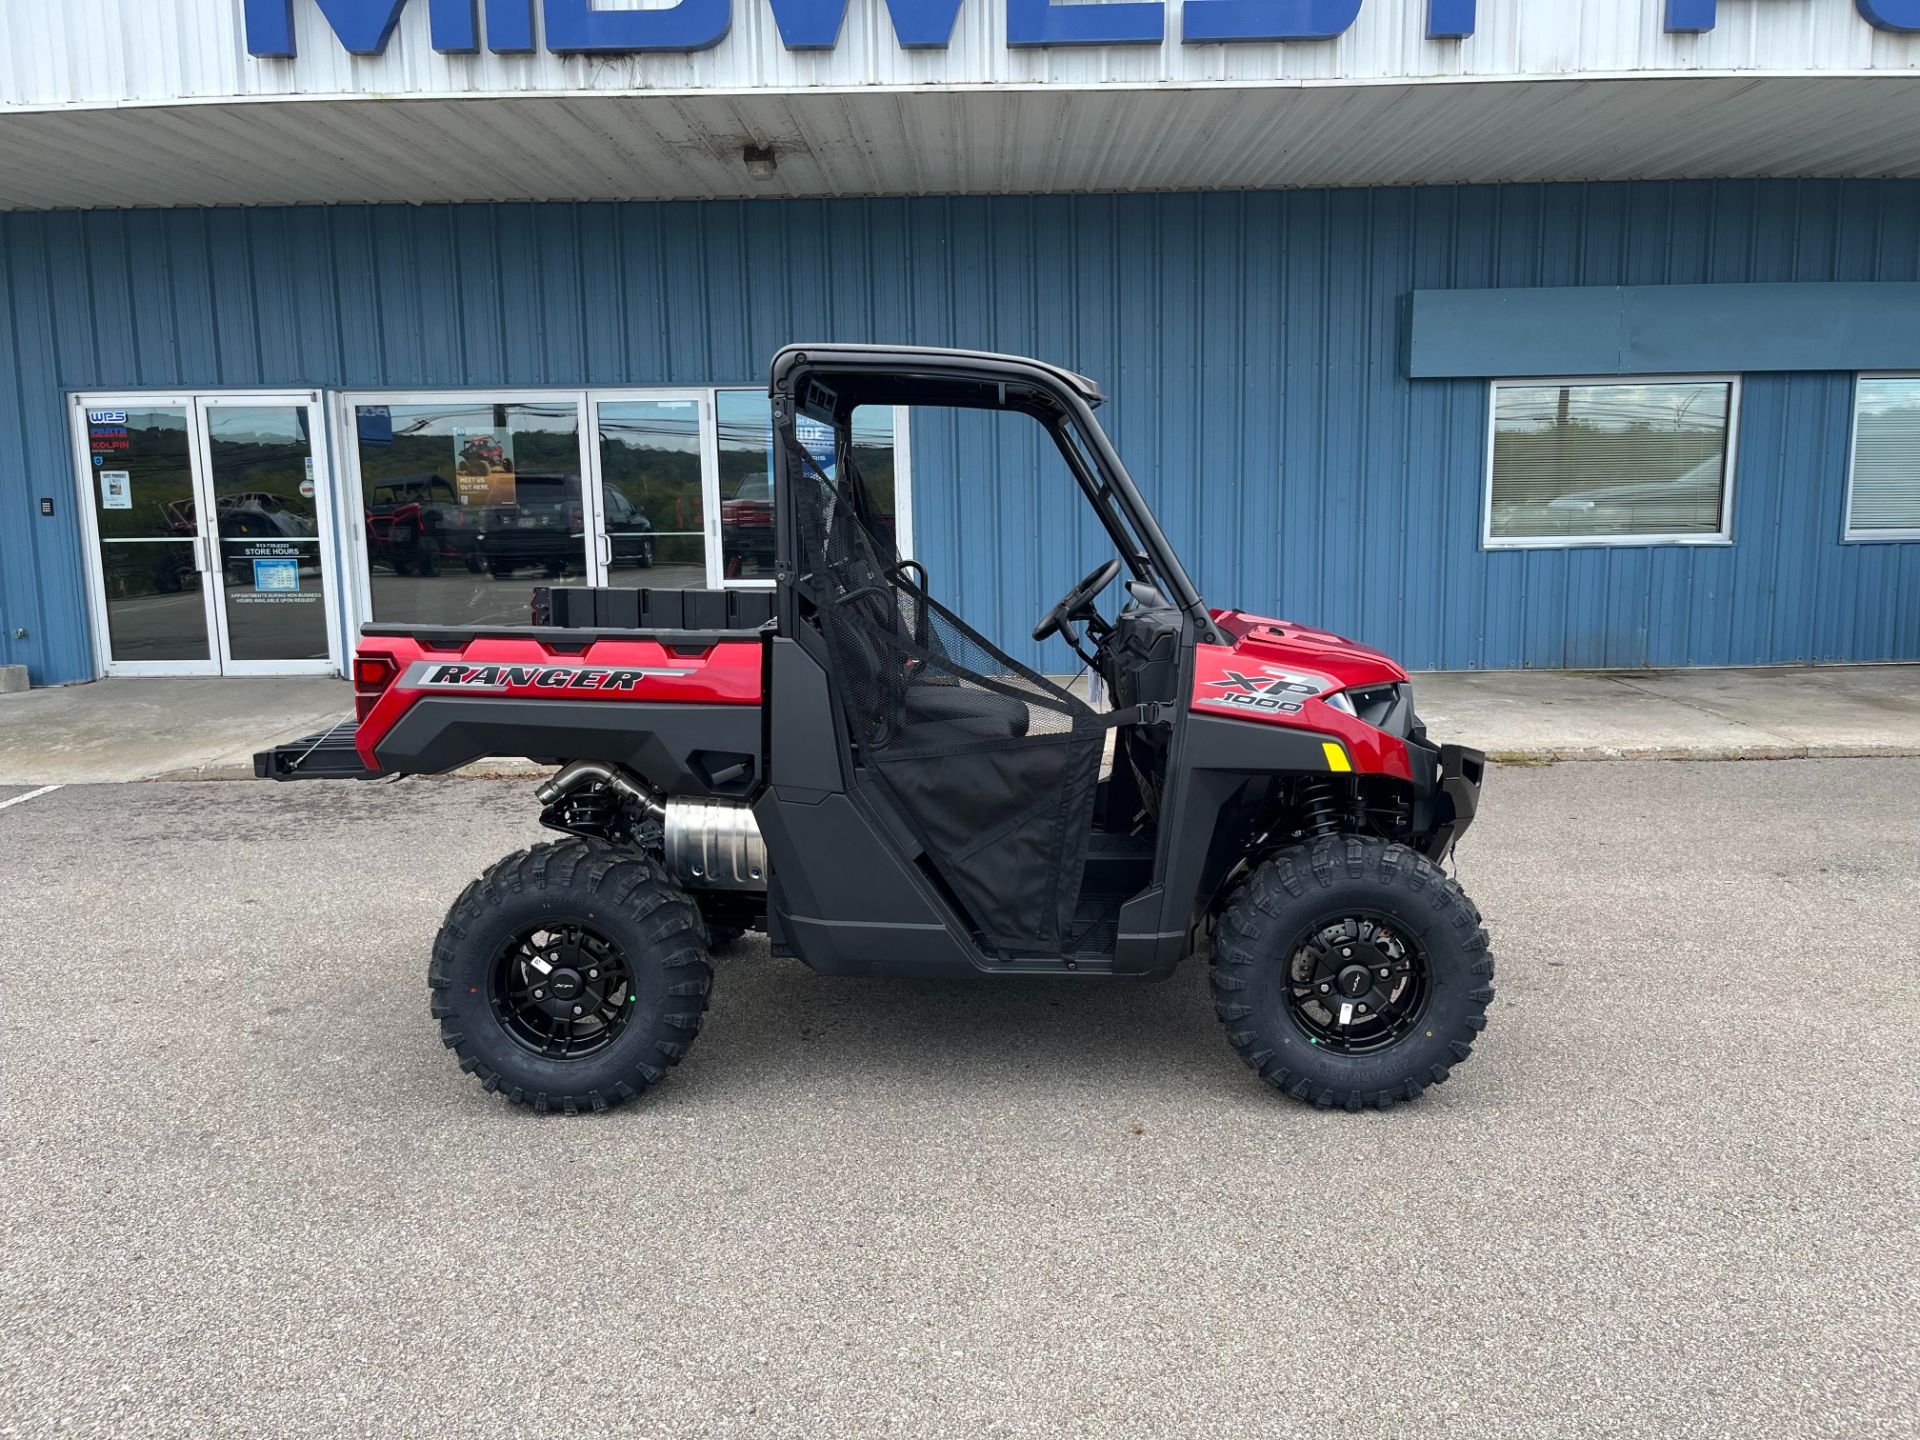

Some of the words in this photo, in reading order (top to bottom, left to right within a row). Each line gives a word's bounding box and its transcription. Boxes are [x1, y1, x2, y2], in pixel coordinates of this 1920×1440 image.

[91, 411, 126, 422] WPS
[796, 427, 825, 439] IDE
[92, 441, 129, 449] KOLPIN
[429, 665, 644, 691] RANGER
[1203, 669, 1322, 696] XP
[1222, 692, 1304, 713] 1000
